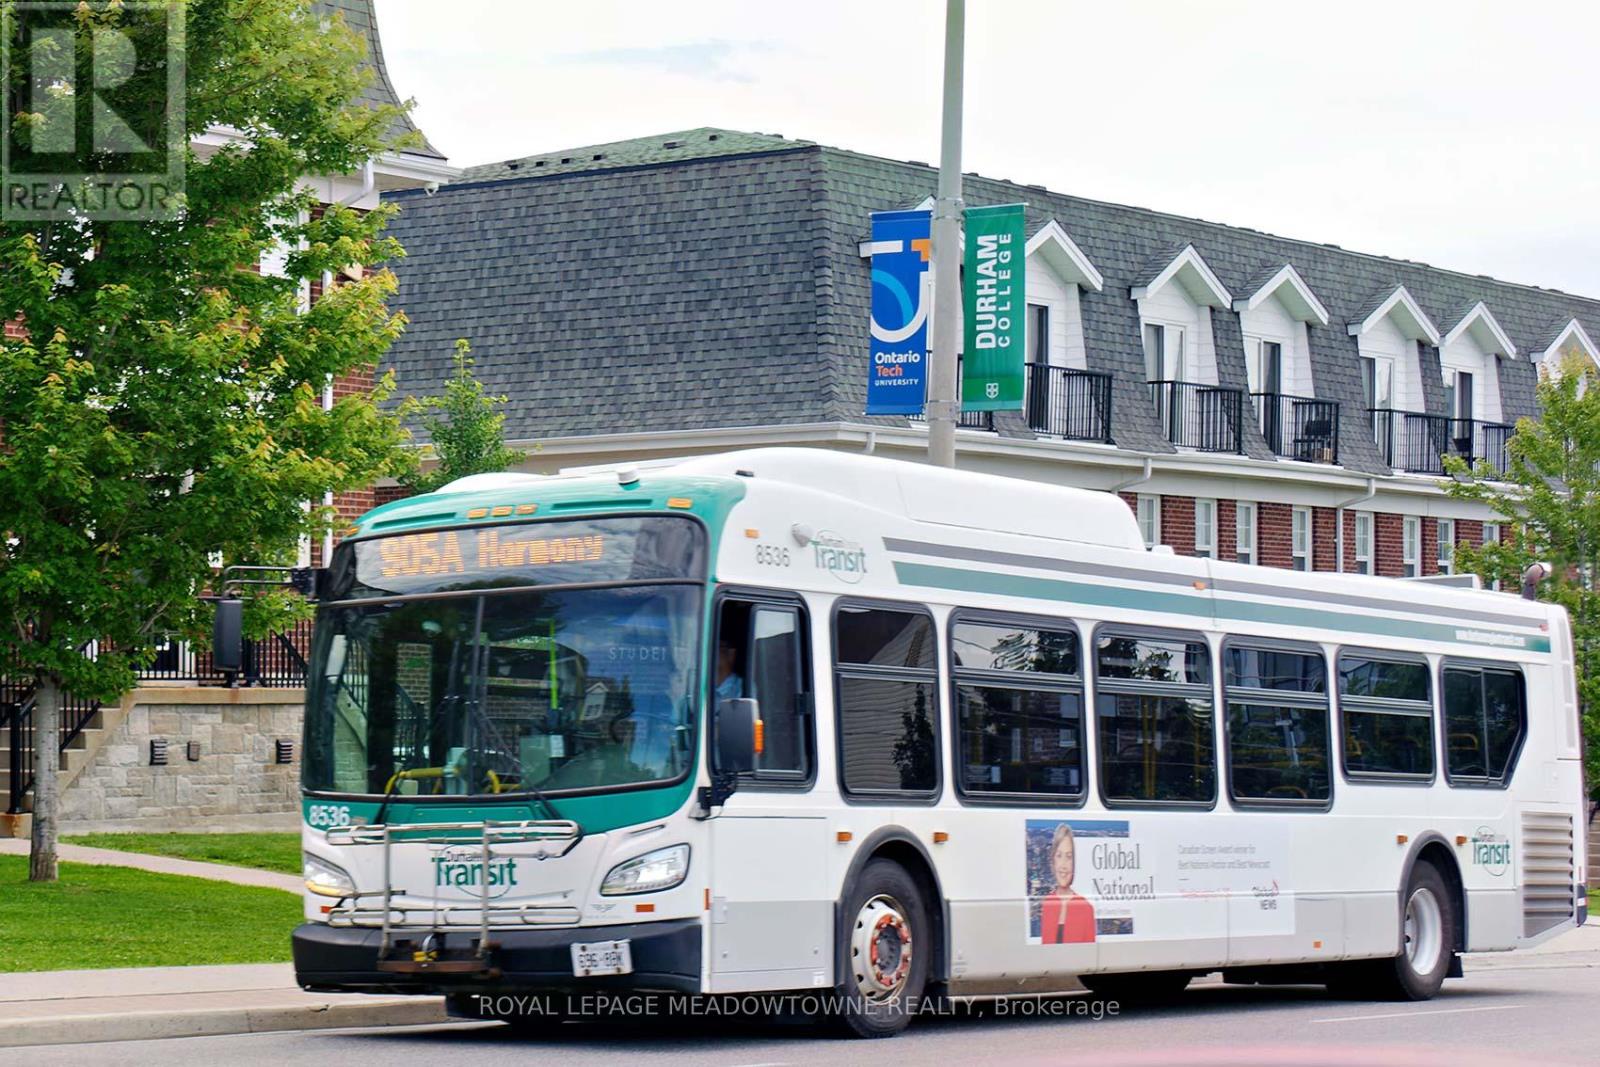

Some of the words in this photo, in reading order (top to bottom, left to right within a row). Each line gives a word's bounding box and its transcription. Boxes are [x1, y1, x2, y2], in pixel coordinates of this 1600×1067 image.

[975, 234, 998, 349] DURHAM
[997, 233, 1012, 348] COLLEGE
[875, 350, 921, 364] Ontario
[876, 364, 903, 377] Tech
[874, 378, 919, 387] UNIVERSITY
[478, 531, 604, 568] Harmony
[756, 544, 791, 567] 8536
[808, 540, 867, 574] Transit
[309, 805, 351, 826] 8536
[1092, 843, 1141, 870] Global
[1472, 838, 1511, 865] Transit
[431, 856, 518, 886] Transit
[1092, 876, 1156, 900] National
